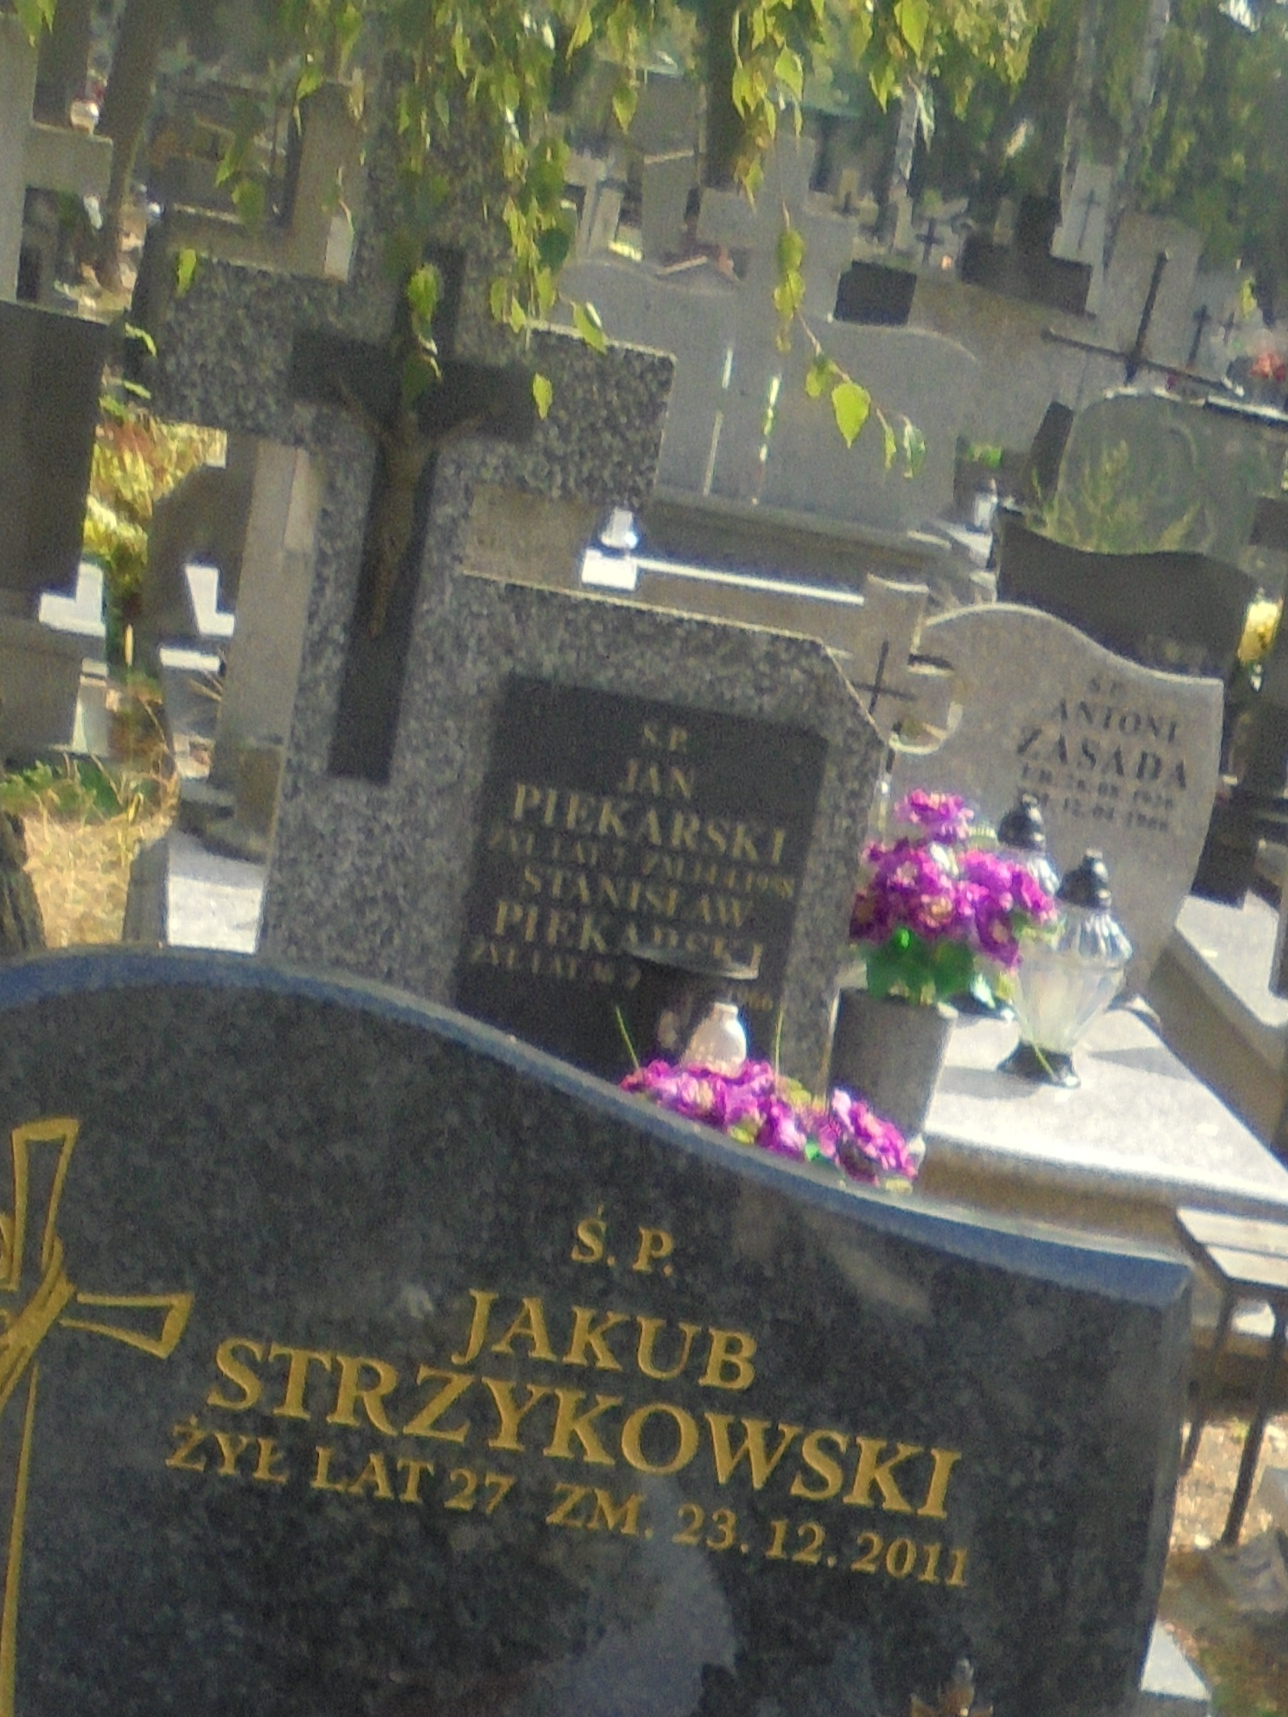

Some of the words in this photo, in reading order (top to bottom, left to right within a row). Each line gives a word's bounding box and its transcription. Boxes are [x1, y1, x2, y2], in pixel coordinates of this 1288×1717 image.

[1015, 727, 1189, 792] ZASADA
[513, 782, 786, 866] PIEKARSKI
[450, 1287, 759, 1393] JAKUB
[164, 1413, 289, 1484] ŻYŁ
[309, 1444, 436, 1504] LAT
[443, 1466, 515, 1516] 27
[545, 1482, 654, 1541] ZM.
[206, 1336, 963, 1520] STRZYKOWSKI
